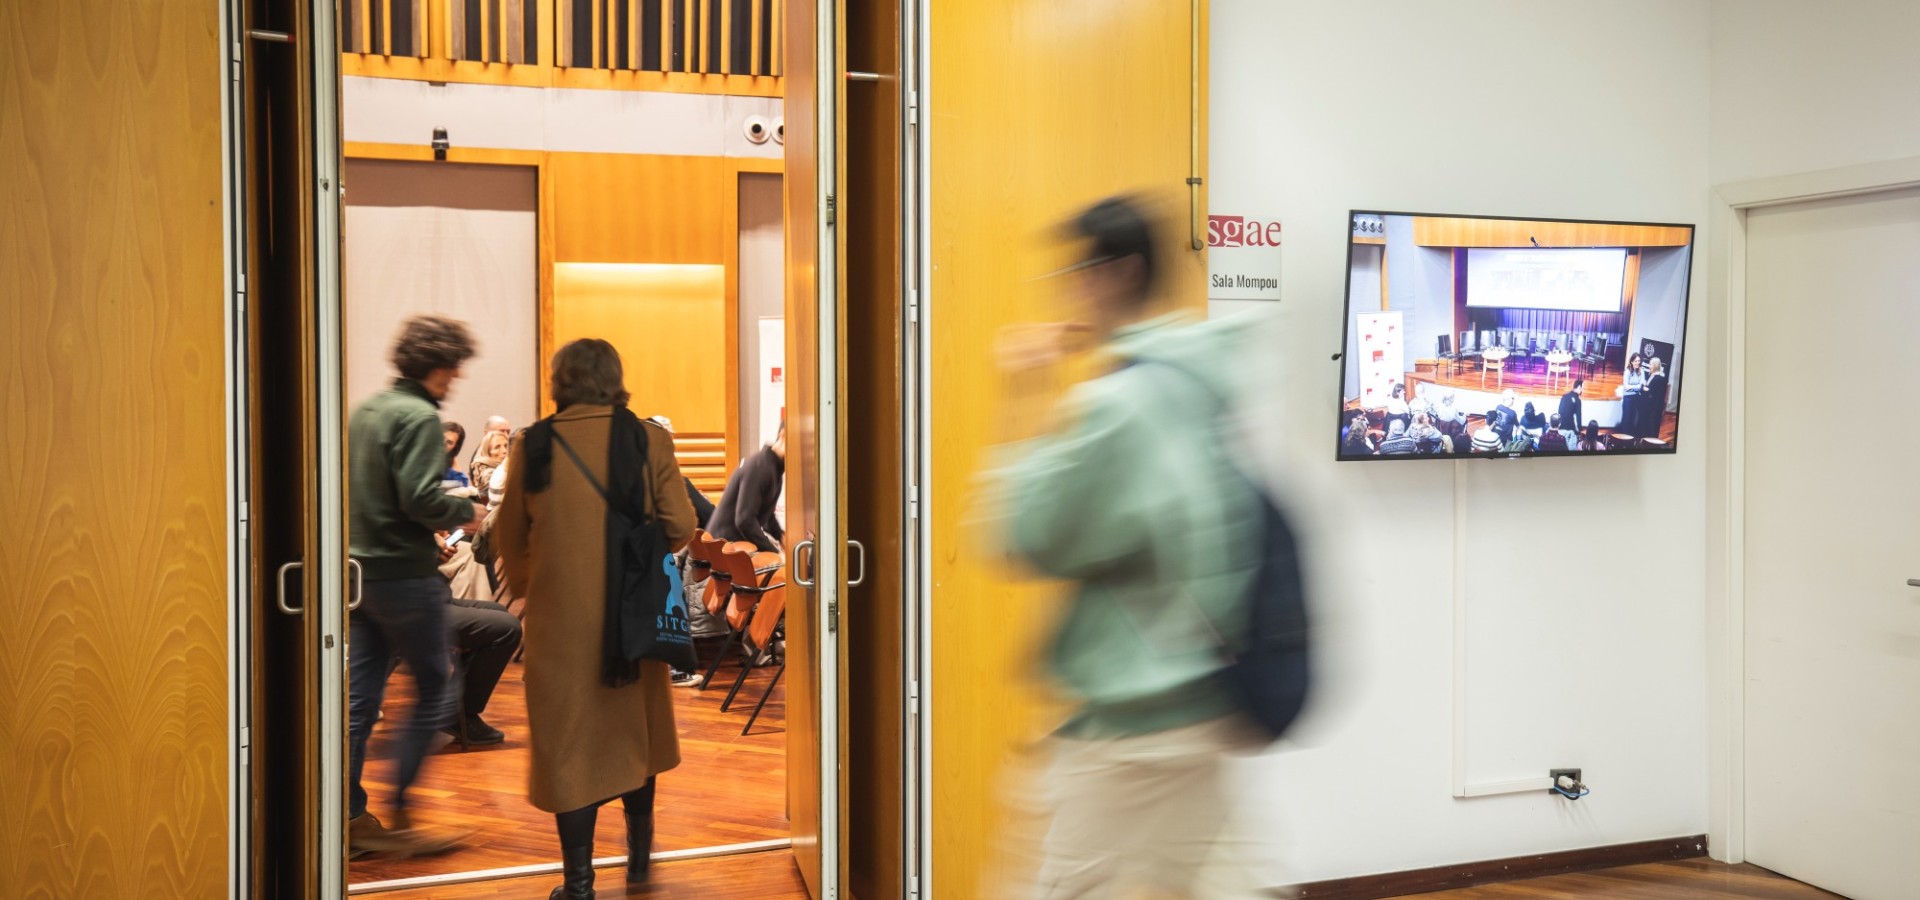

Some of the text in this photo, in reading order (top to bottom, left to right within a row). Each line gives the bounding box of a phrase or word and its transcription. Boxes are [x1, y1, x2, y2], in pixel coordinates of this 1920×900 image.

[1208, 220, 1281, 247] sgae
[1212, 273, 1278, 291] Sala Mompou
